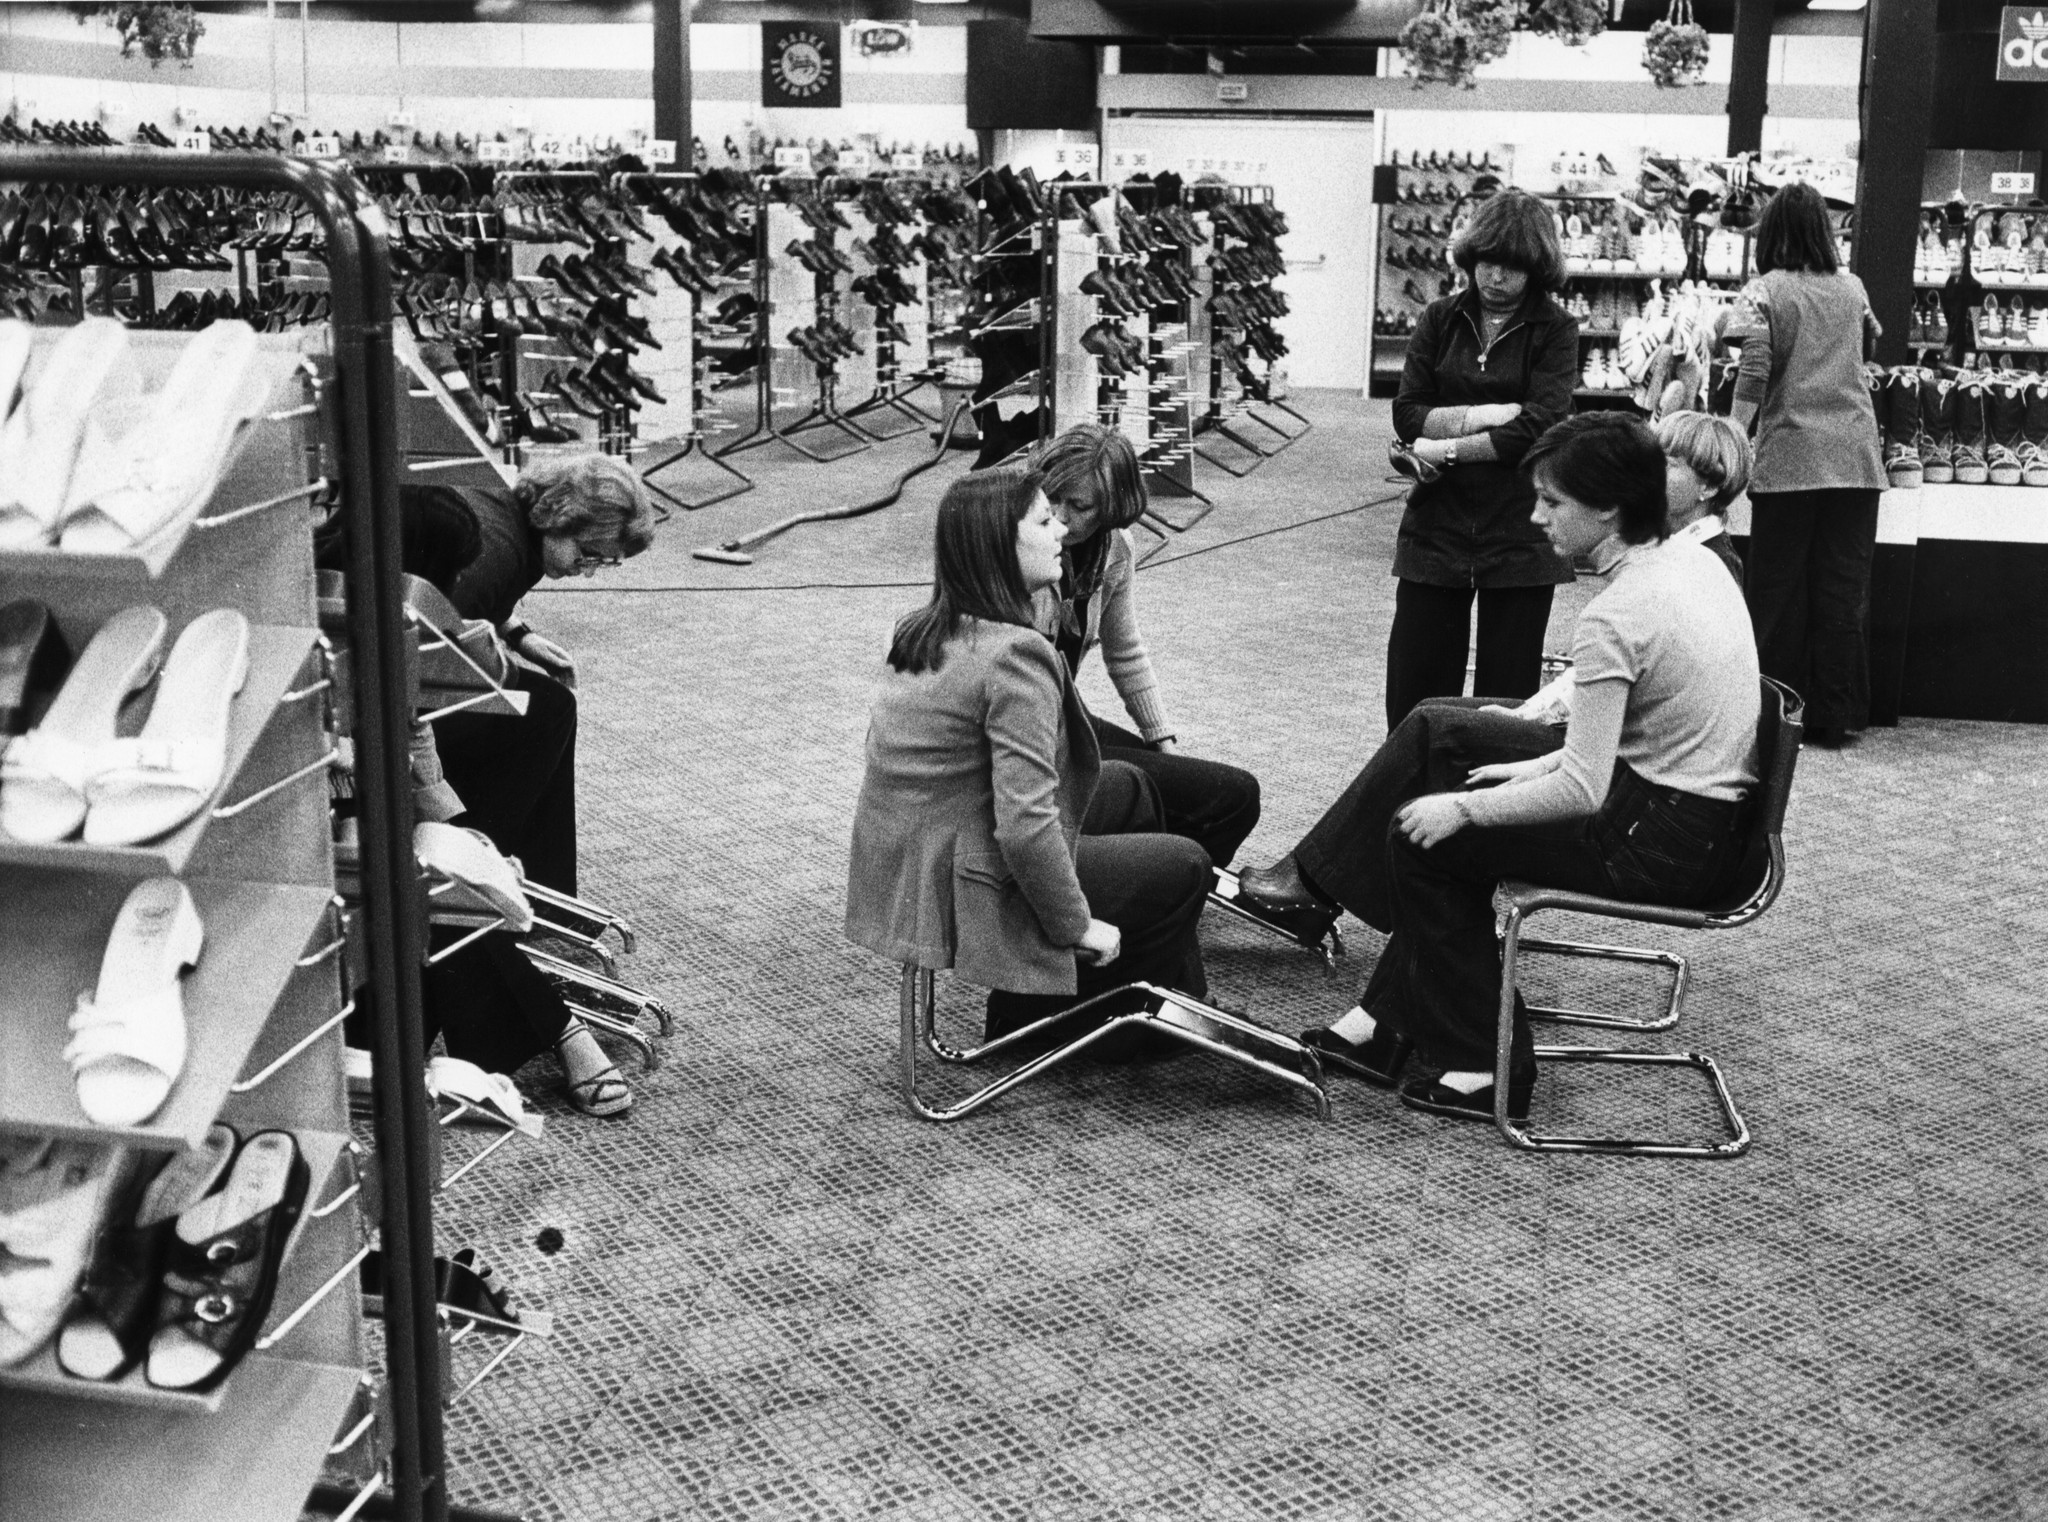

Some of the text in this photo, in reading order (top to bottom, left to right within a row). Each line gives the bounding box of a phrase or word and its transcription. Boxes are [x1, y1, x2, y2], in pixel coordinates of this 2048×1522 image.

[183, 138, 201, 150] 41
[314, 142, 330, 154] 41
[541, 141, 560, 154] 42
[650, 148, 669, 159] 43
[1075, 150, 1092, 163] 36
[1568, 162, 1587, 175] 44
[1997, 177, 2012, 189] 38
